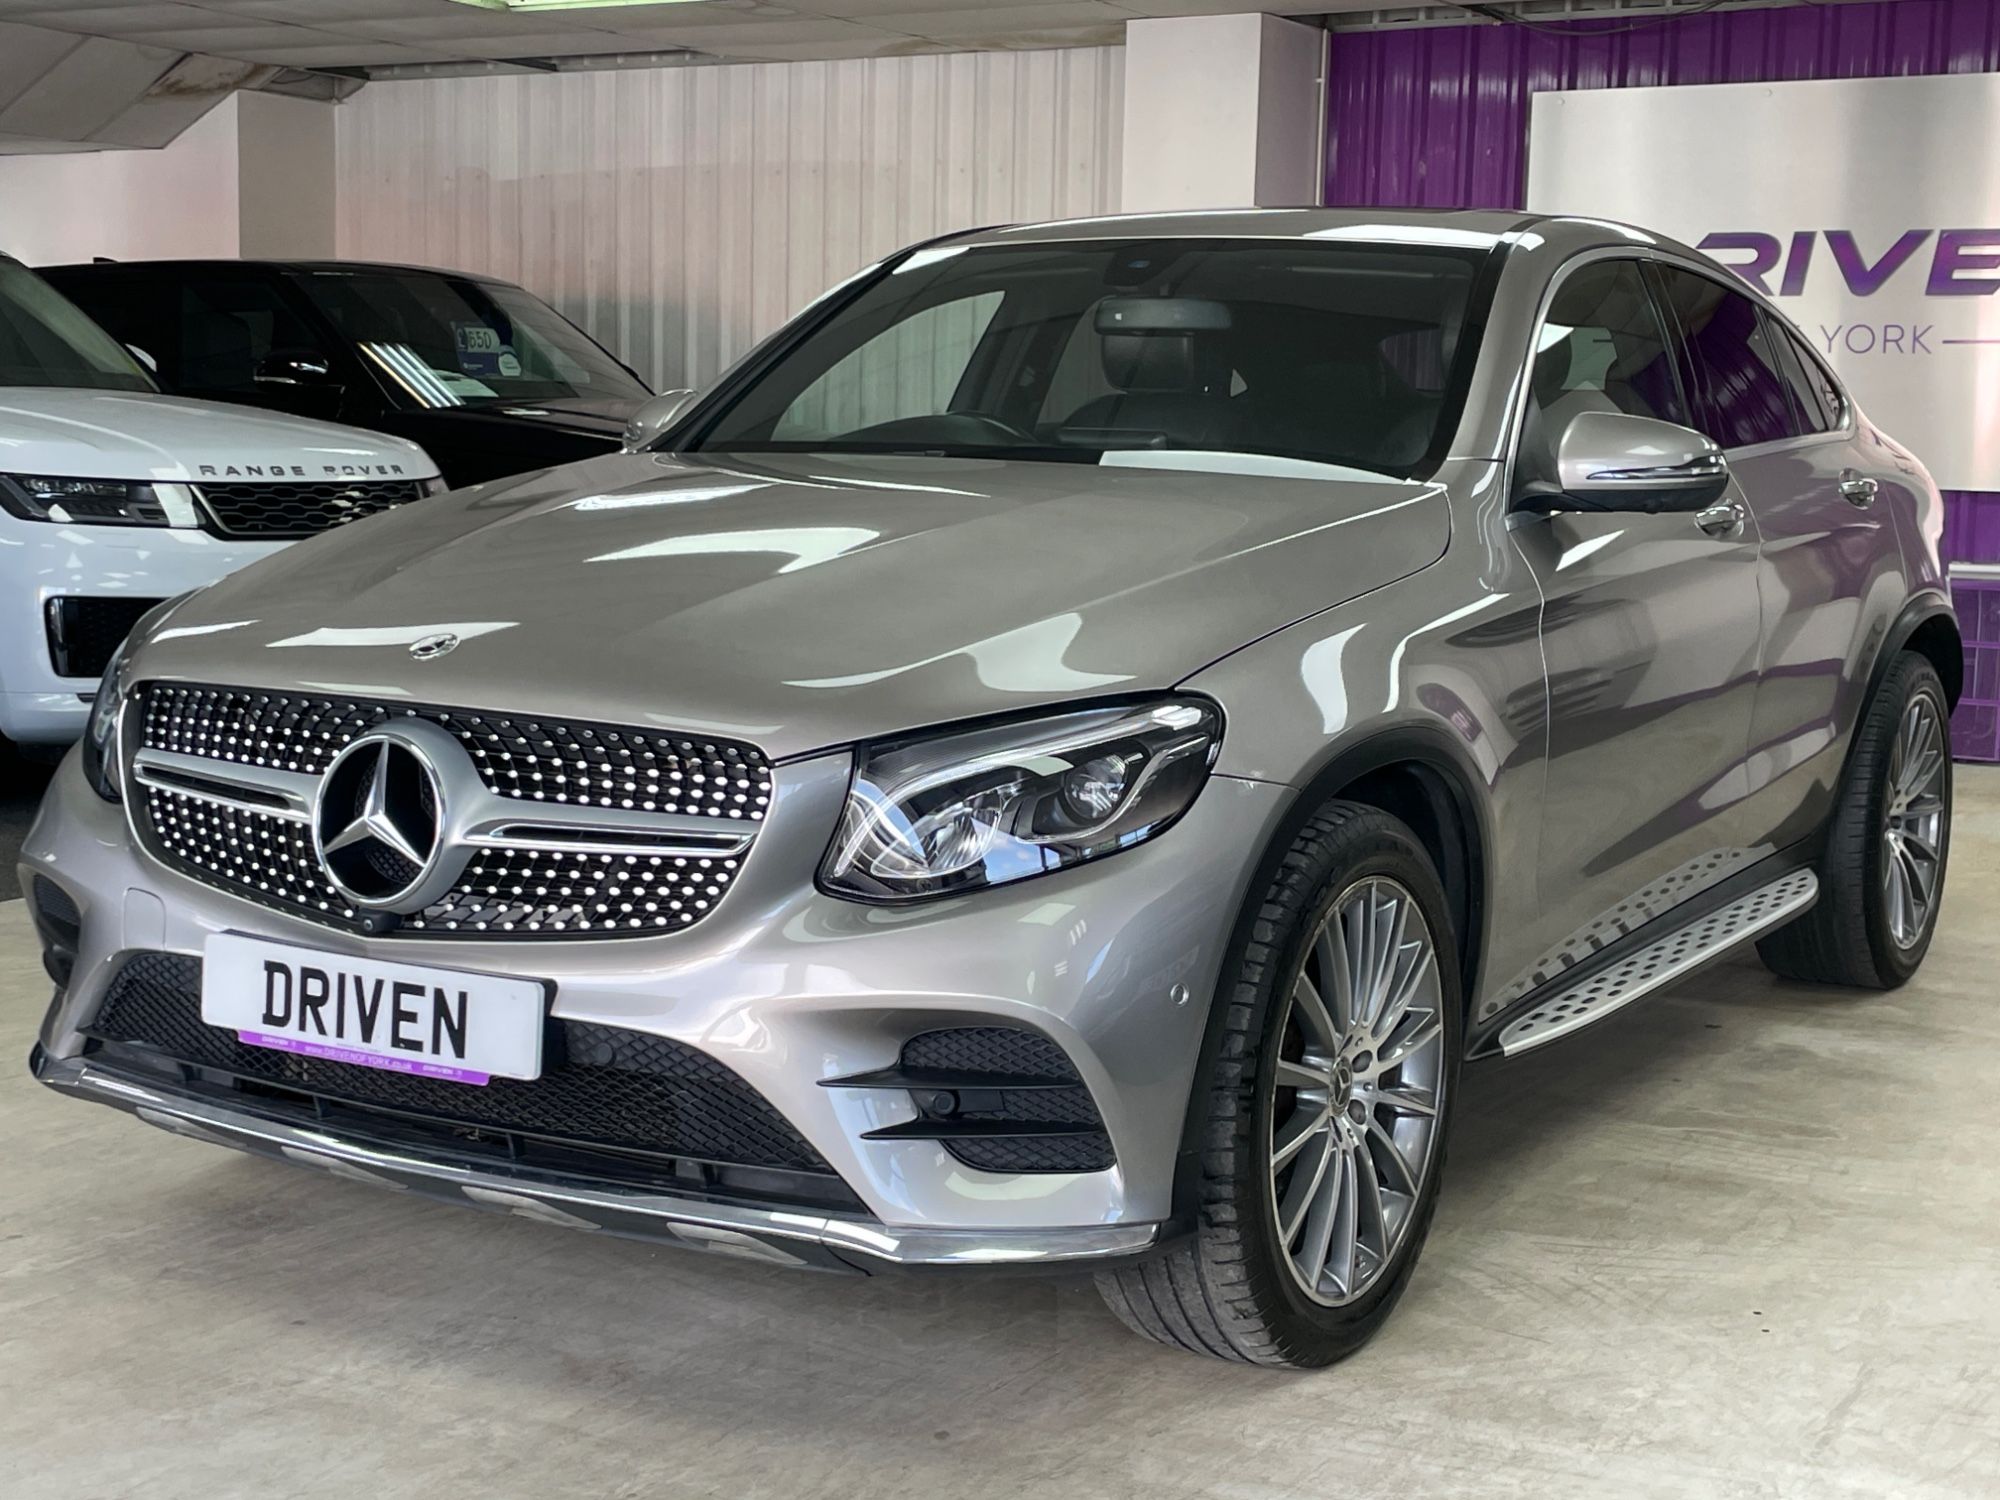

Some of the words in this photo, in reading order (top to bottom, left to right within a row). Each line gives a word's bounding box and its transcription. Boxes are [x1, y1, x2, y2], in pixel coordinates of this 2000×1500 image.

[1696, 229, 2000, 296] RIVE
[1820, 324, 1934, 354] YORK
[199, 464, 305, 476] RANGE
[323, 464, 404, 475] ROVER
[262, 960, 468, 1059] DRIVEN
